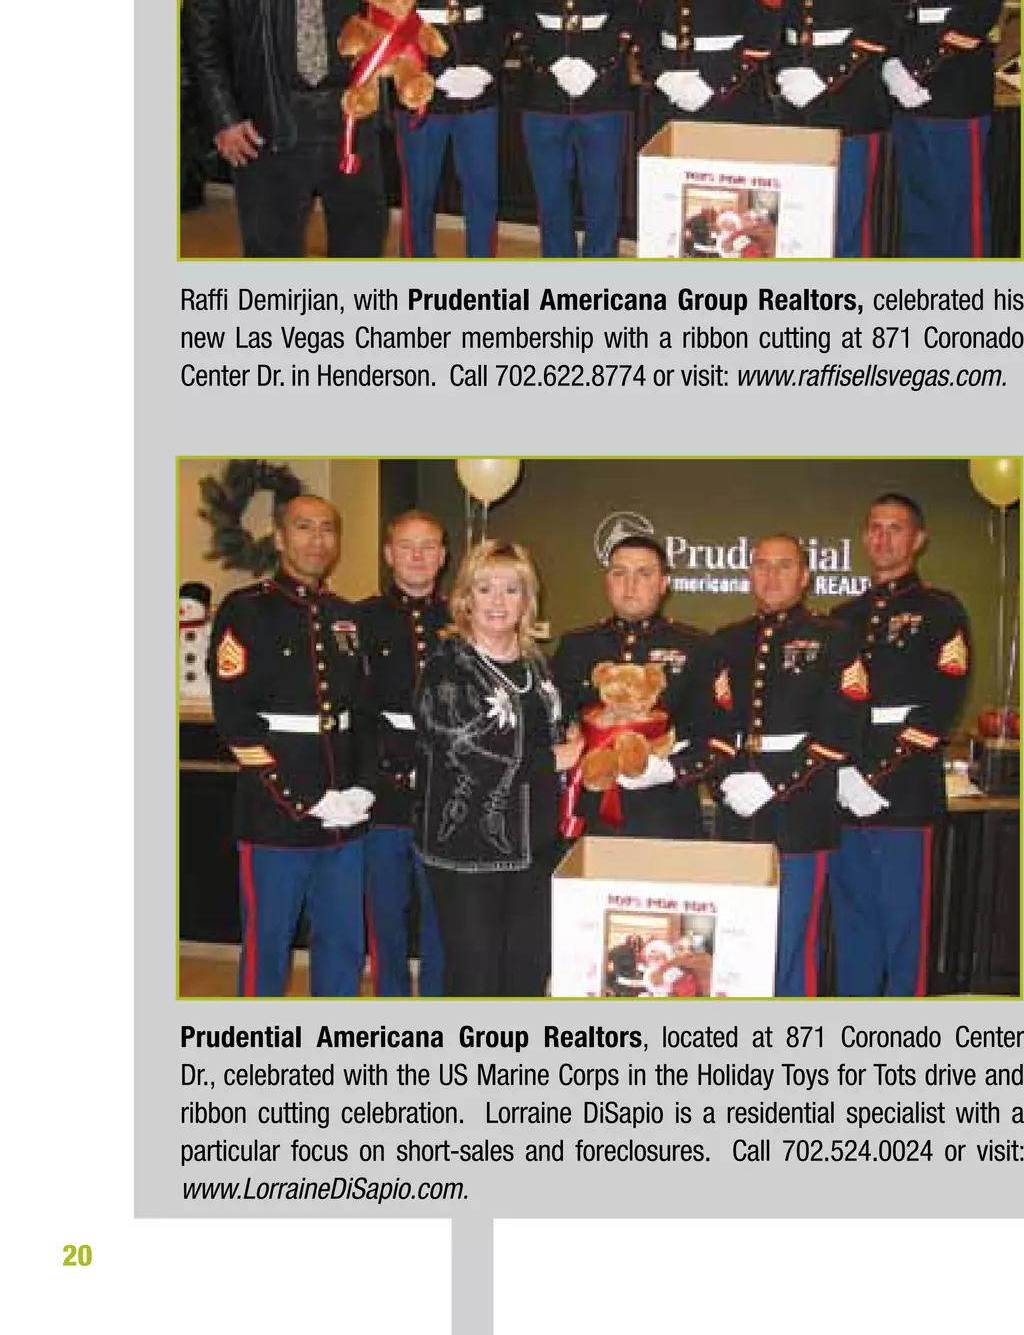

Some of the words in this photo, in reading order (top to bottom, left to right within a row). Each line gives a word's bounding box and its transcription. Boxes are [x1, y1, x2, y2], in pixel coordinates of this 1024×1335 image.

[182, 288, 227, 311] Raffi
[239, 289, 344, 316] Demirjian,
[354, 288, 397, 310] with
[409, 288, 529, 311] Prudential
[540, 288, 666, 311] Americana
[678, 288, 747, 315] Group
[759, 289, 863, 315] Realtors,
[874, 289, 983, 311] celebrated
[995, 289, 1024, 311] his
[181, 364, 250, 386] Center
[258, 364, 284, 386] Dr.
[292, 364, 309, 386] in
[318, 364, 435, 386] Henderson.
[450, 364, 487, 386] Call
[496, 365, 646, 386] 702.622.8774
[653, 369, 675, 386] or
[681, 364, 728, 386] visit:
[738, 364, 1006, 391] www.raffisellsvegas.com.
[181, 1025, 301, 1048] Prudential
[316, 1025, 443, 1048] Americana
[459, 1025, 528, 1053] Group
[545, 1026, 648, 1051] Realtors,
[663, 1026, 737, 1048] located
[752, 1026, 773, 1048] at
[786, 1026, 822, 1048] 871
[842, 1025, 941, 1048] Coronado
[956, 1025, 1024, 1048] Center
[182, 1139, 280, 1166] particular
[291, 1139, 348, 1161] focus
[360, 1144, 384, 1161] on
[397, 1139, 514, 1162] short-sales
[526, 1140, 563, 1162] and
[575, 1139, 710, 1162] foreclosures.
[733, 1139, 770, 1161] Call
[783, 1140, 933, 1162] 702.524.0024
[945, 1144, 966, 1161] or
[977, 1140, 1024, 1162] visit:
[184, 1177, 468, 1204] www.LorraineDiSapio.com.
[63, 1244, 92, 1266] 20
